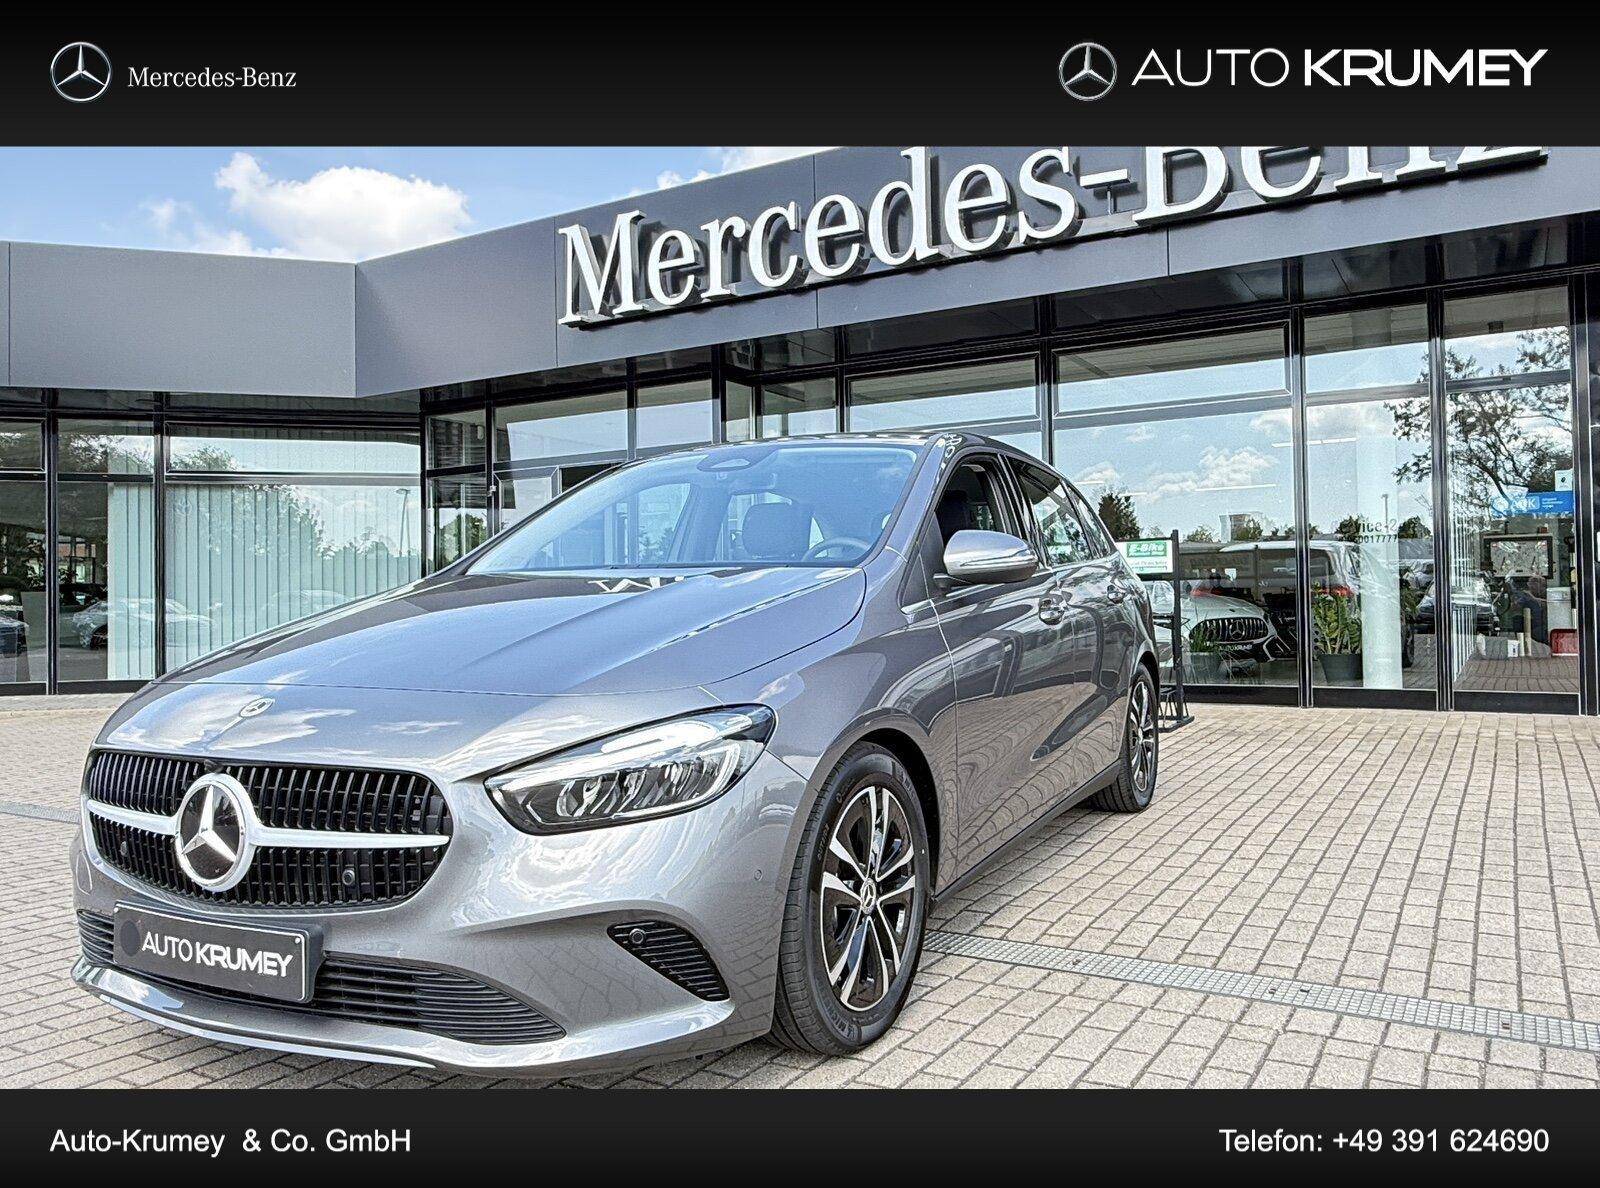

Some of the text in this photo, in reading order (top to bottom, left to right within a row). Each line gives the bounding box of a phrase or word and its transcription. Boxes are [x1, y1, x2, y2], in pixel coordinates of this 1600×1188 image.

[557, 145, 1549, 328] Mercedes-Be
[141, 931, 294, 978] AUTO KRUMEY
